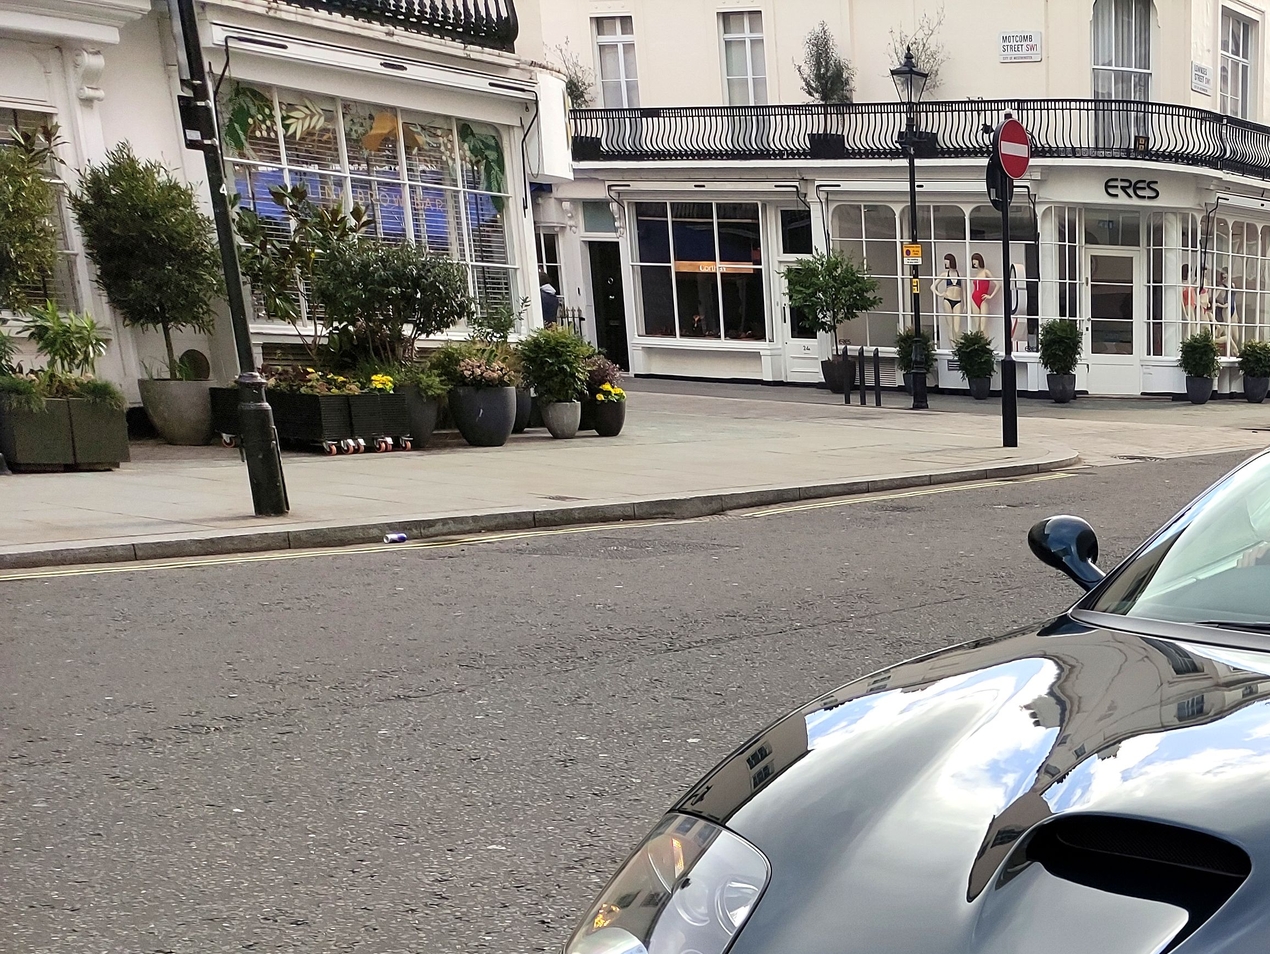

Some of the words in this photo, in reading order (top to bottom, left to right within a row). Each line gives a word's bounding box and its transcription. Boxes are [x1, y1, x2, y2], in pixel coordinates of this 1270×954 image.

[1002, 35, 1032, 43] MOTCOMB
[1002, 44, 1024, 52] STREET
[1104, 178, 1160, 200] ERES
